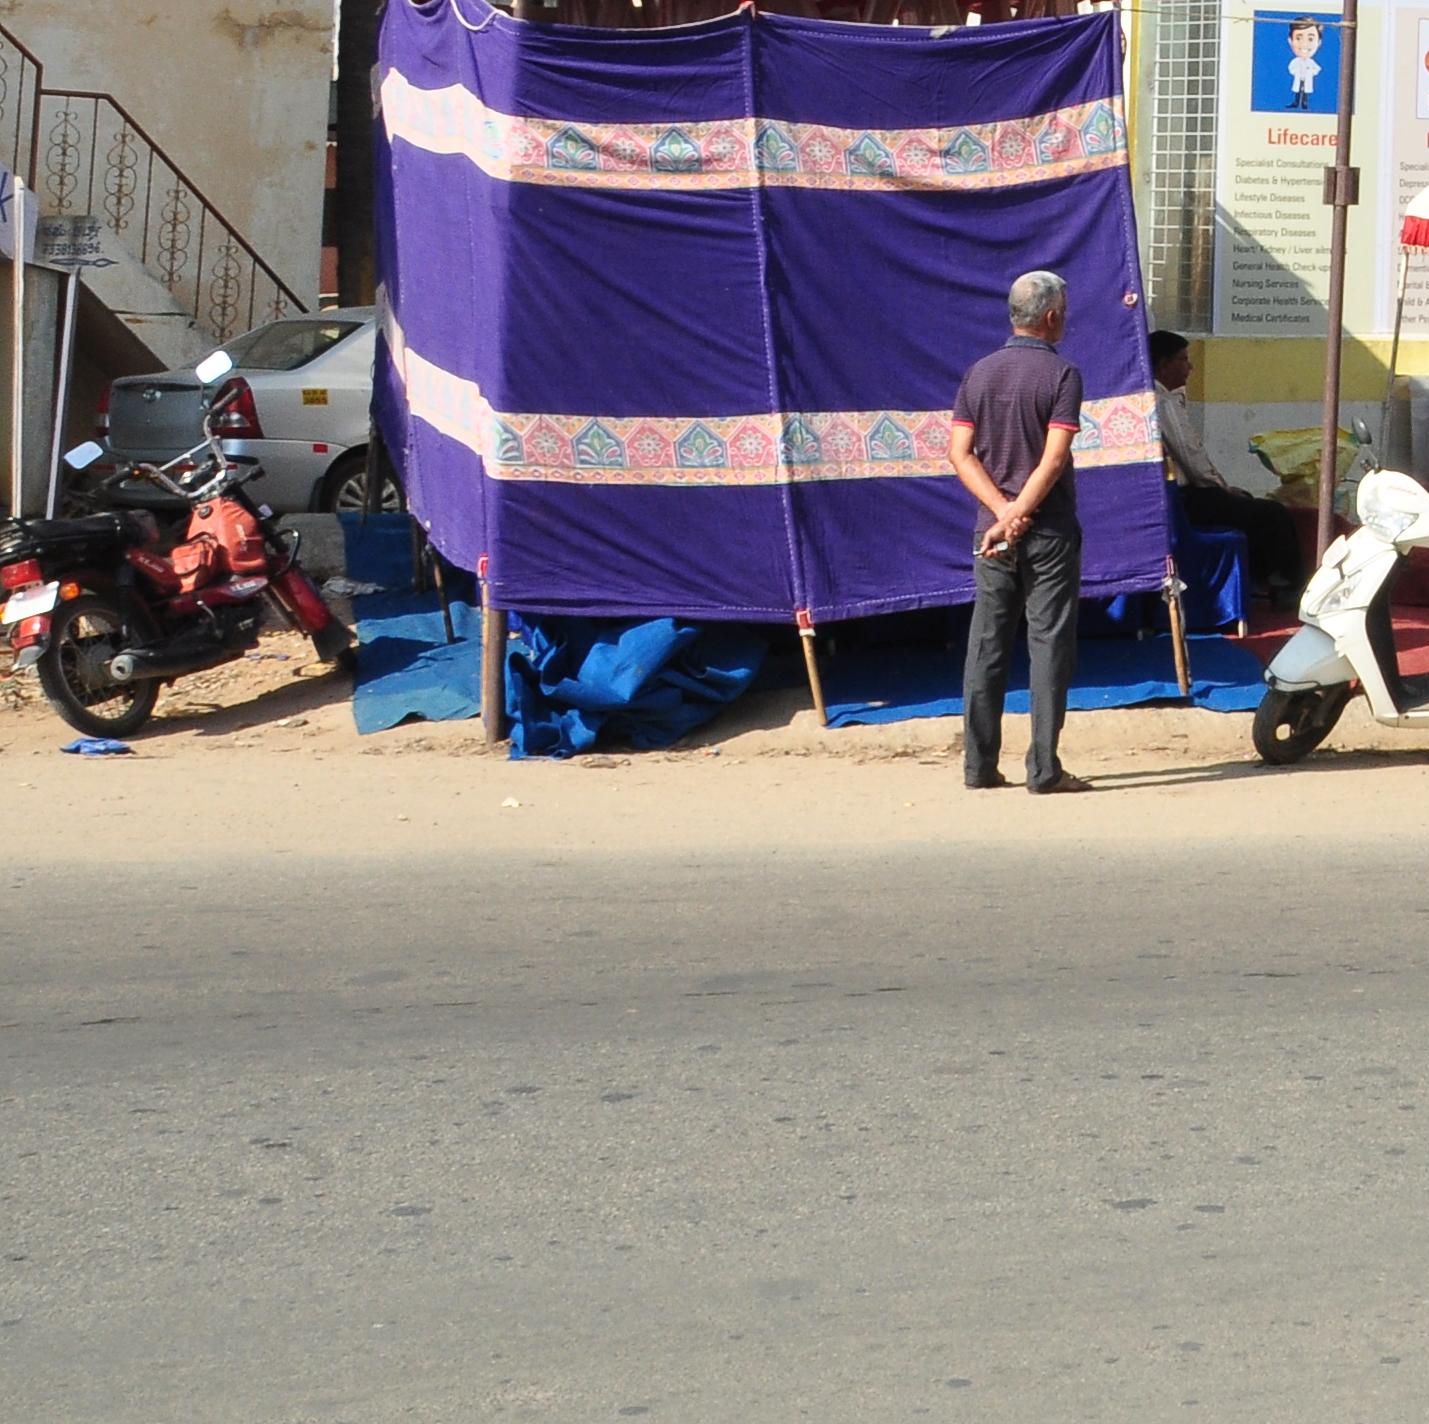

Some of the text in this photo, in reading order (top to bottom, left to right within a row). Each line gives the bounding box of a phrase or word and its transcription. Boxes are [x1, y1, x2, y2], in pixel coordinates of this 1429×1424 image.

[1268, 128, 1338, 146] Lifecare
[1235, 158, 1274, 168] Specialist
[1235, 175, 1269, 184] Diabetes
[1235, 193, 1305, 202] Lifestyle Diseases
[1234, 210, 1310, 220] Infectious Diseases
[1234, 227, 1316, 238] Respiratory Diseases
[1294, 246, 1312, 254] Liver
[1233, 261, 1290, 271] General Health
[1232, 279, 1299, 289] Nursing Services
[1232, 296, 1298, 306] Corporate Health
[1231, 313, 1309, 323] Medical Certificates
